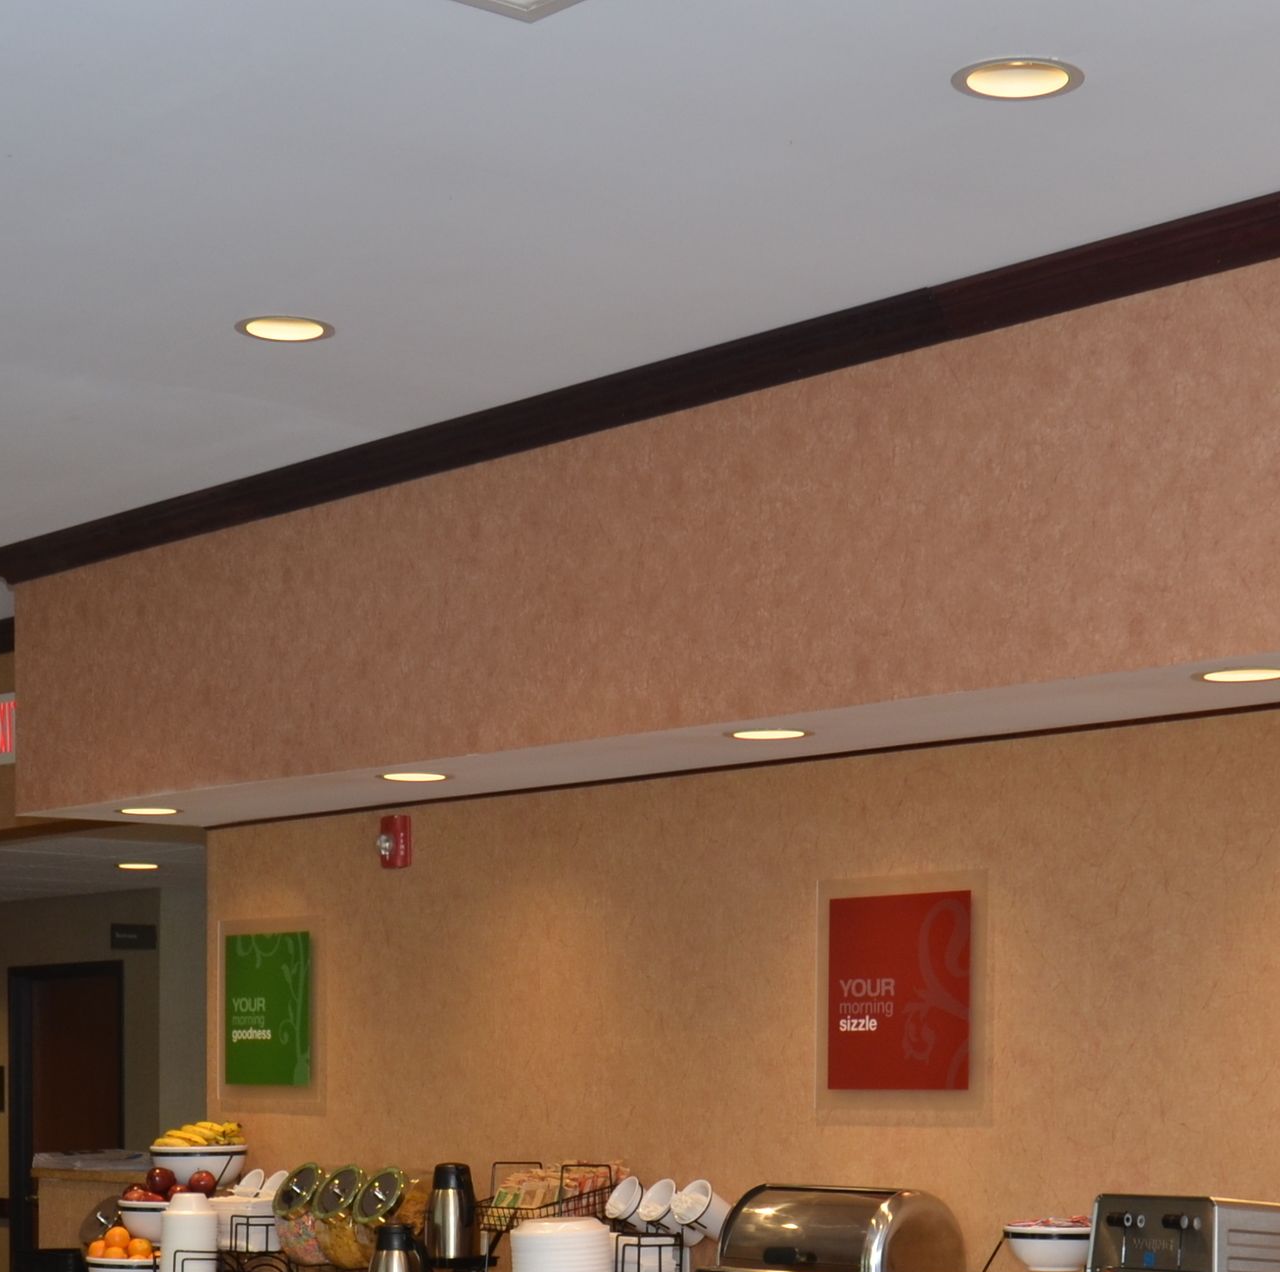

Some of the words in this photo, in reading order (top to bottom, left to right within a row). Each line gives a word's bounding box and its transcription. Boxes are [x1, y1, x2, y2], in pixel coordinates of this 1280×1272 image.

[840, 978, 896, 997] YOUR
[232, 997, 266, 1012] YOUR
[839, 998, 894, 1018] morning
[232, 1014, 265, 1028] morning
[839, 1015, 878, 1032] sizzle
[231, 1026, 272, 1043] goodness
